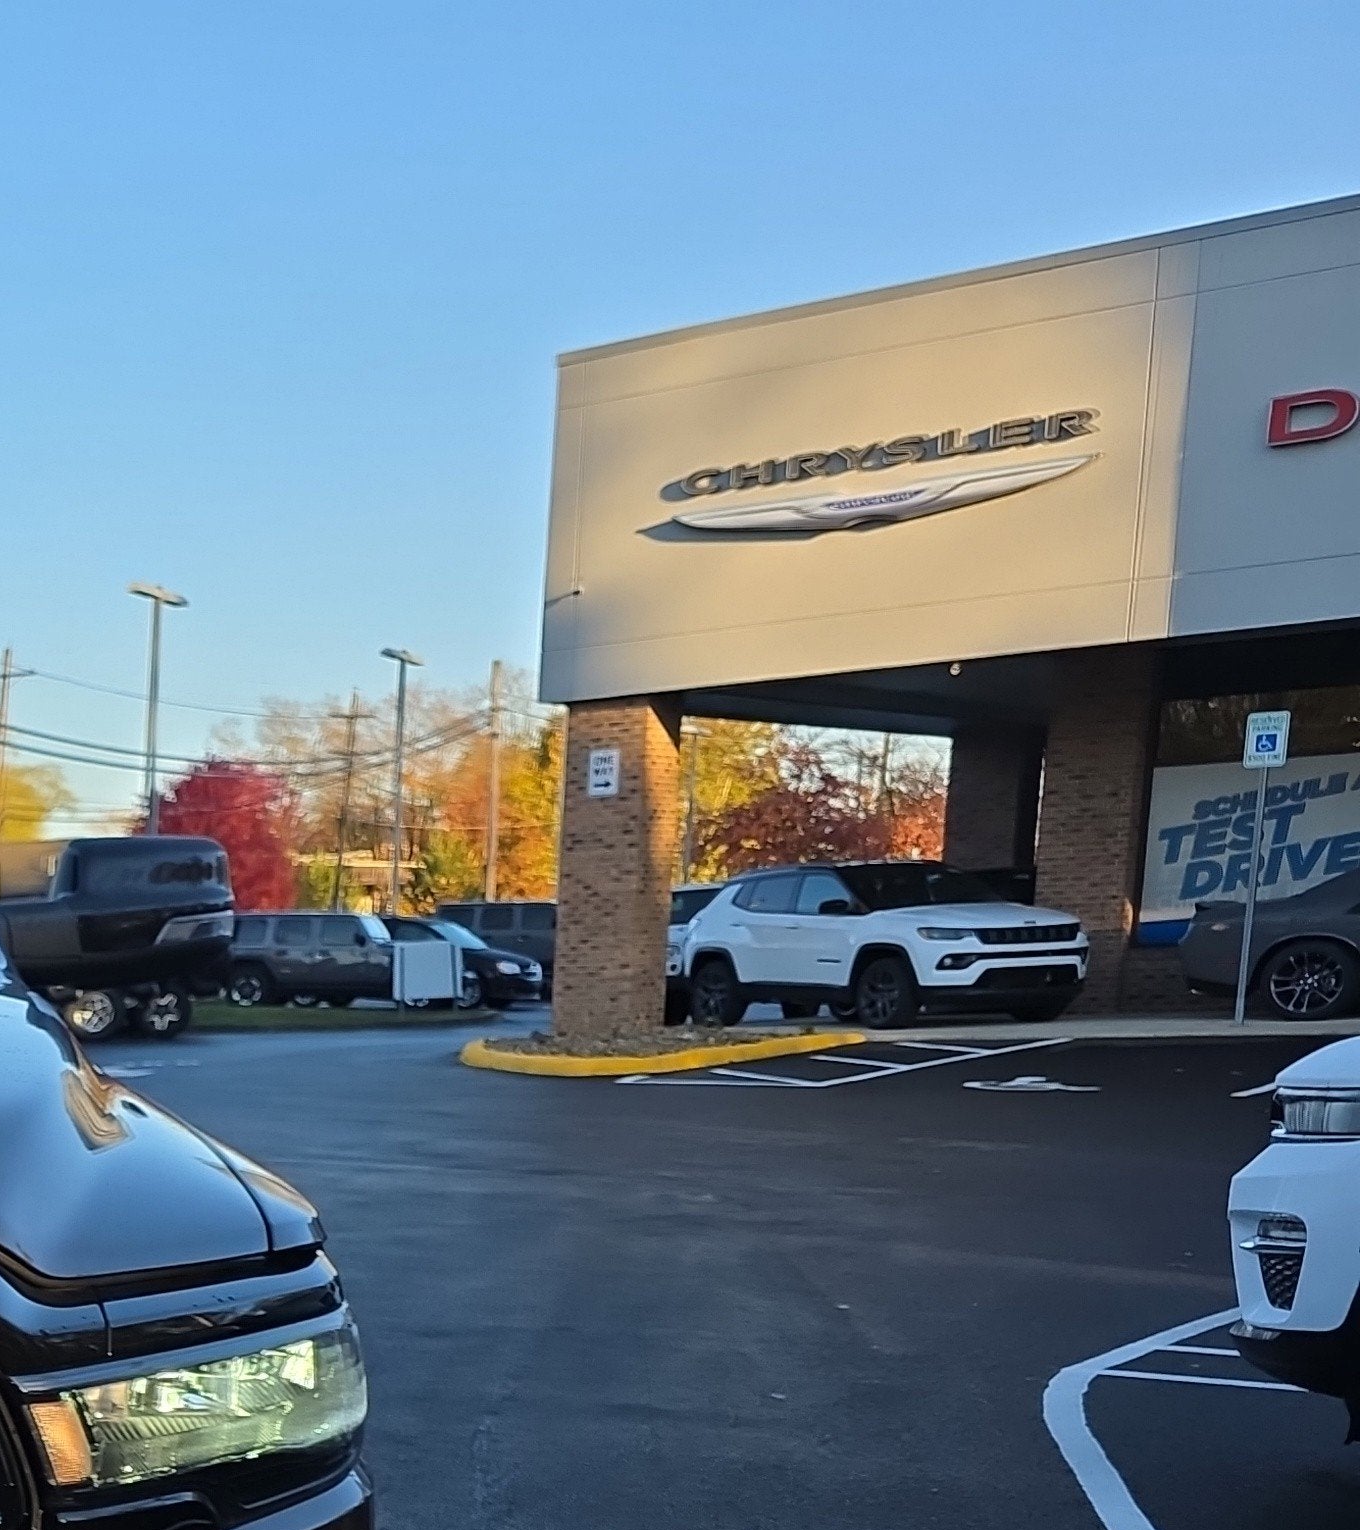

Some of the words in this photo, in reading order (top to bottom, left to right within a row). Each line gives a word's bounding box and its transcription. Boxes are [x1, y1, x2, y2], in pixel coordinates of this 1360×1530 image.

[679, 407, 1100, 494] CHRYSLER
[1158, 802, 1306, 865] TEST
[1179, 832, 1360, 900] DRIVE
